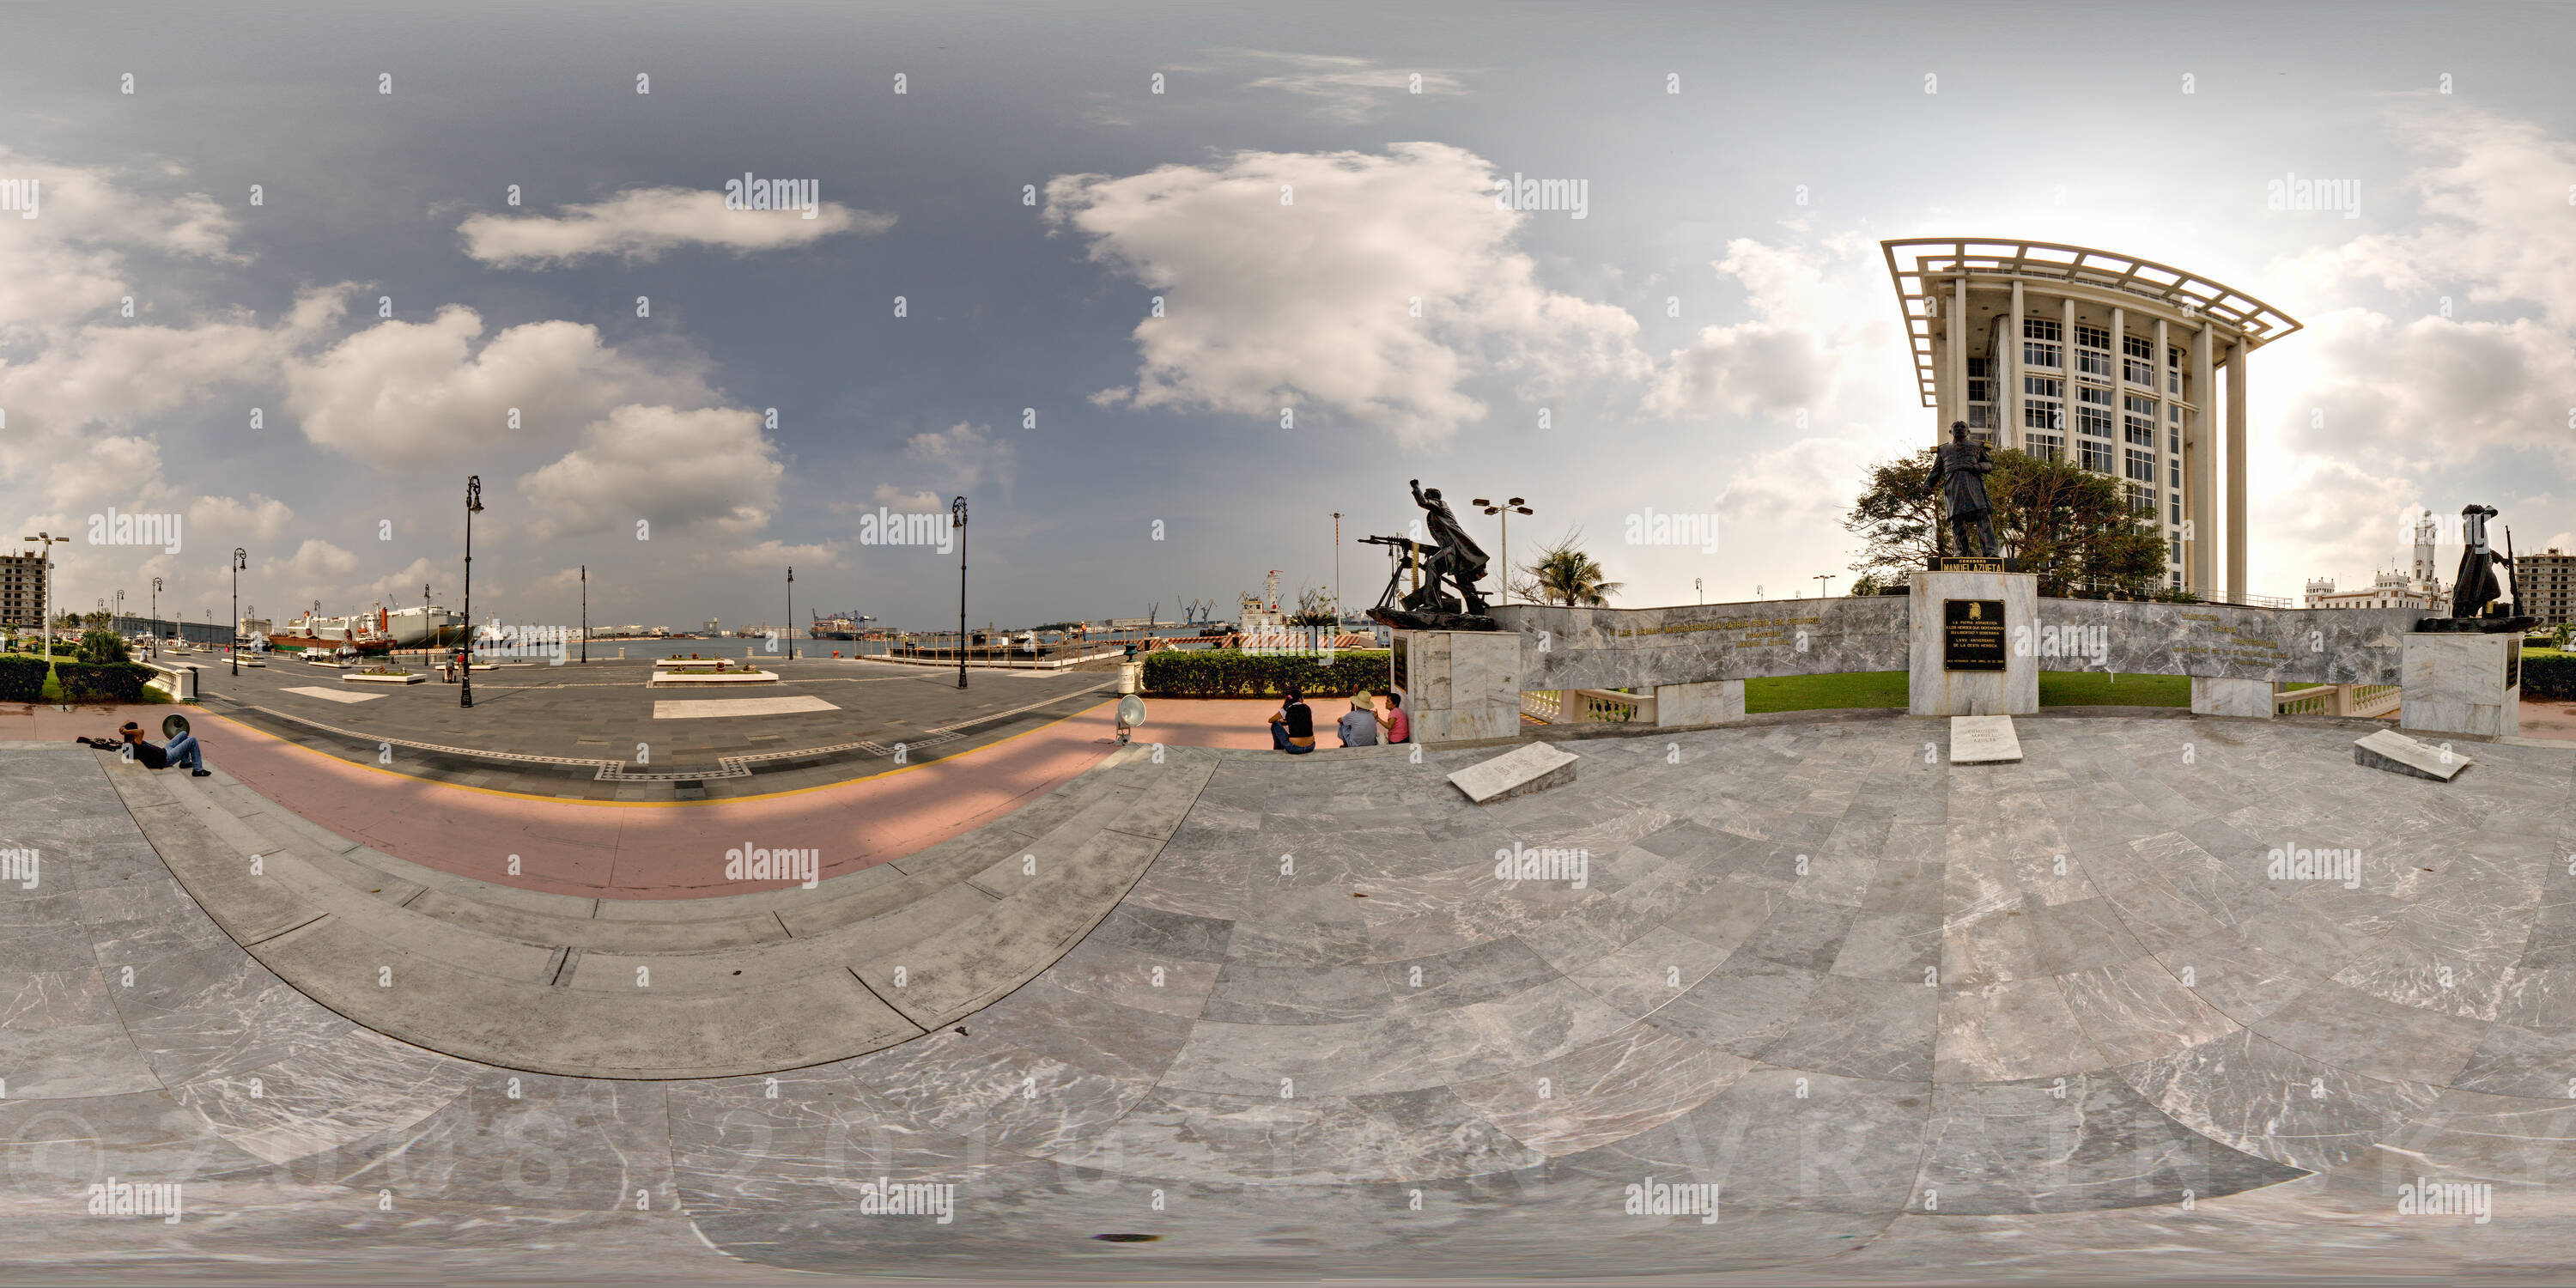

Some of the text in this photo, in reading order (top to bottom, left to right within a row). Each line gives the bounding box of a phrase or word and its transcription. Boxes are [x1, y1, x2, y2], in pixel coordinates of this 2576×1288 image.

[1973, 563, 2002, 572] AZUETA
[1723, 620, 1748, 629] PATRIA
[1774, 617, 1784, 626] EN
